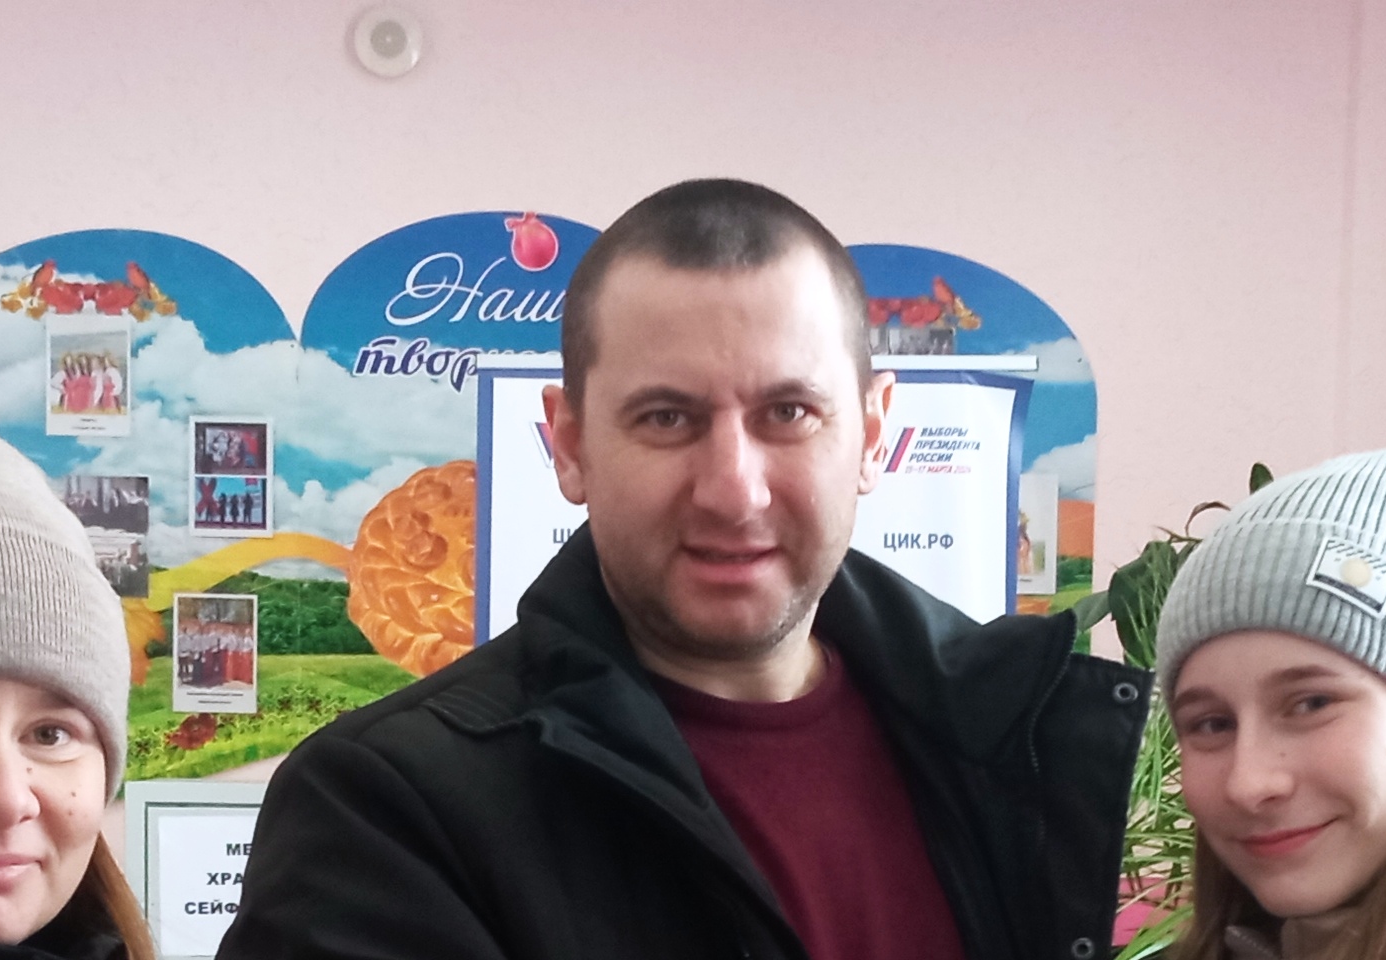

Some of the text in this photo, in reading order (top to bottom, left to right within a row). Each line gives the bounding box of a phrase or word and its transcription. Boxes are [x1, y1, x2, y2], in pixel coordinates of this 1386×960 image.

[386, 252, 566, 326] Наш
[353, 337, 561, 392] твор
[920, 427, 968, 437] ВЫБОРЫ
[914, 440, 981, 451] ПРЕЗИДЕНТА
[909, 453, 953, 463] РОССИИ
[883, 532, 954, 552] ЦИК.РФ
[206, 872, 244, 886] ХРА
[184, 899, 240, 915] СЕЙФ
